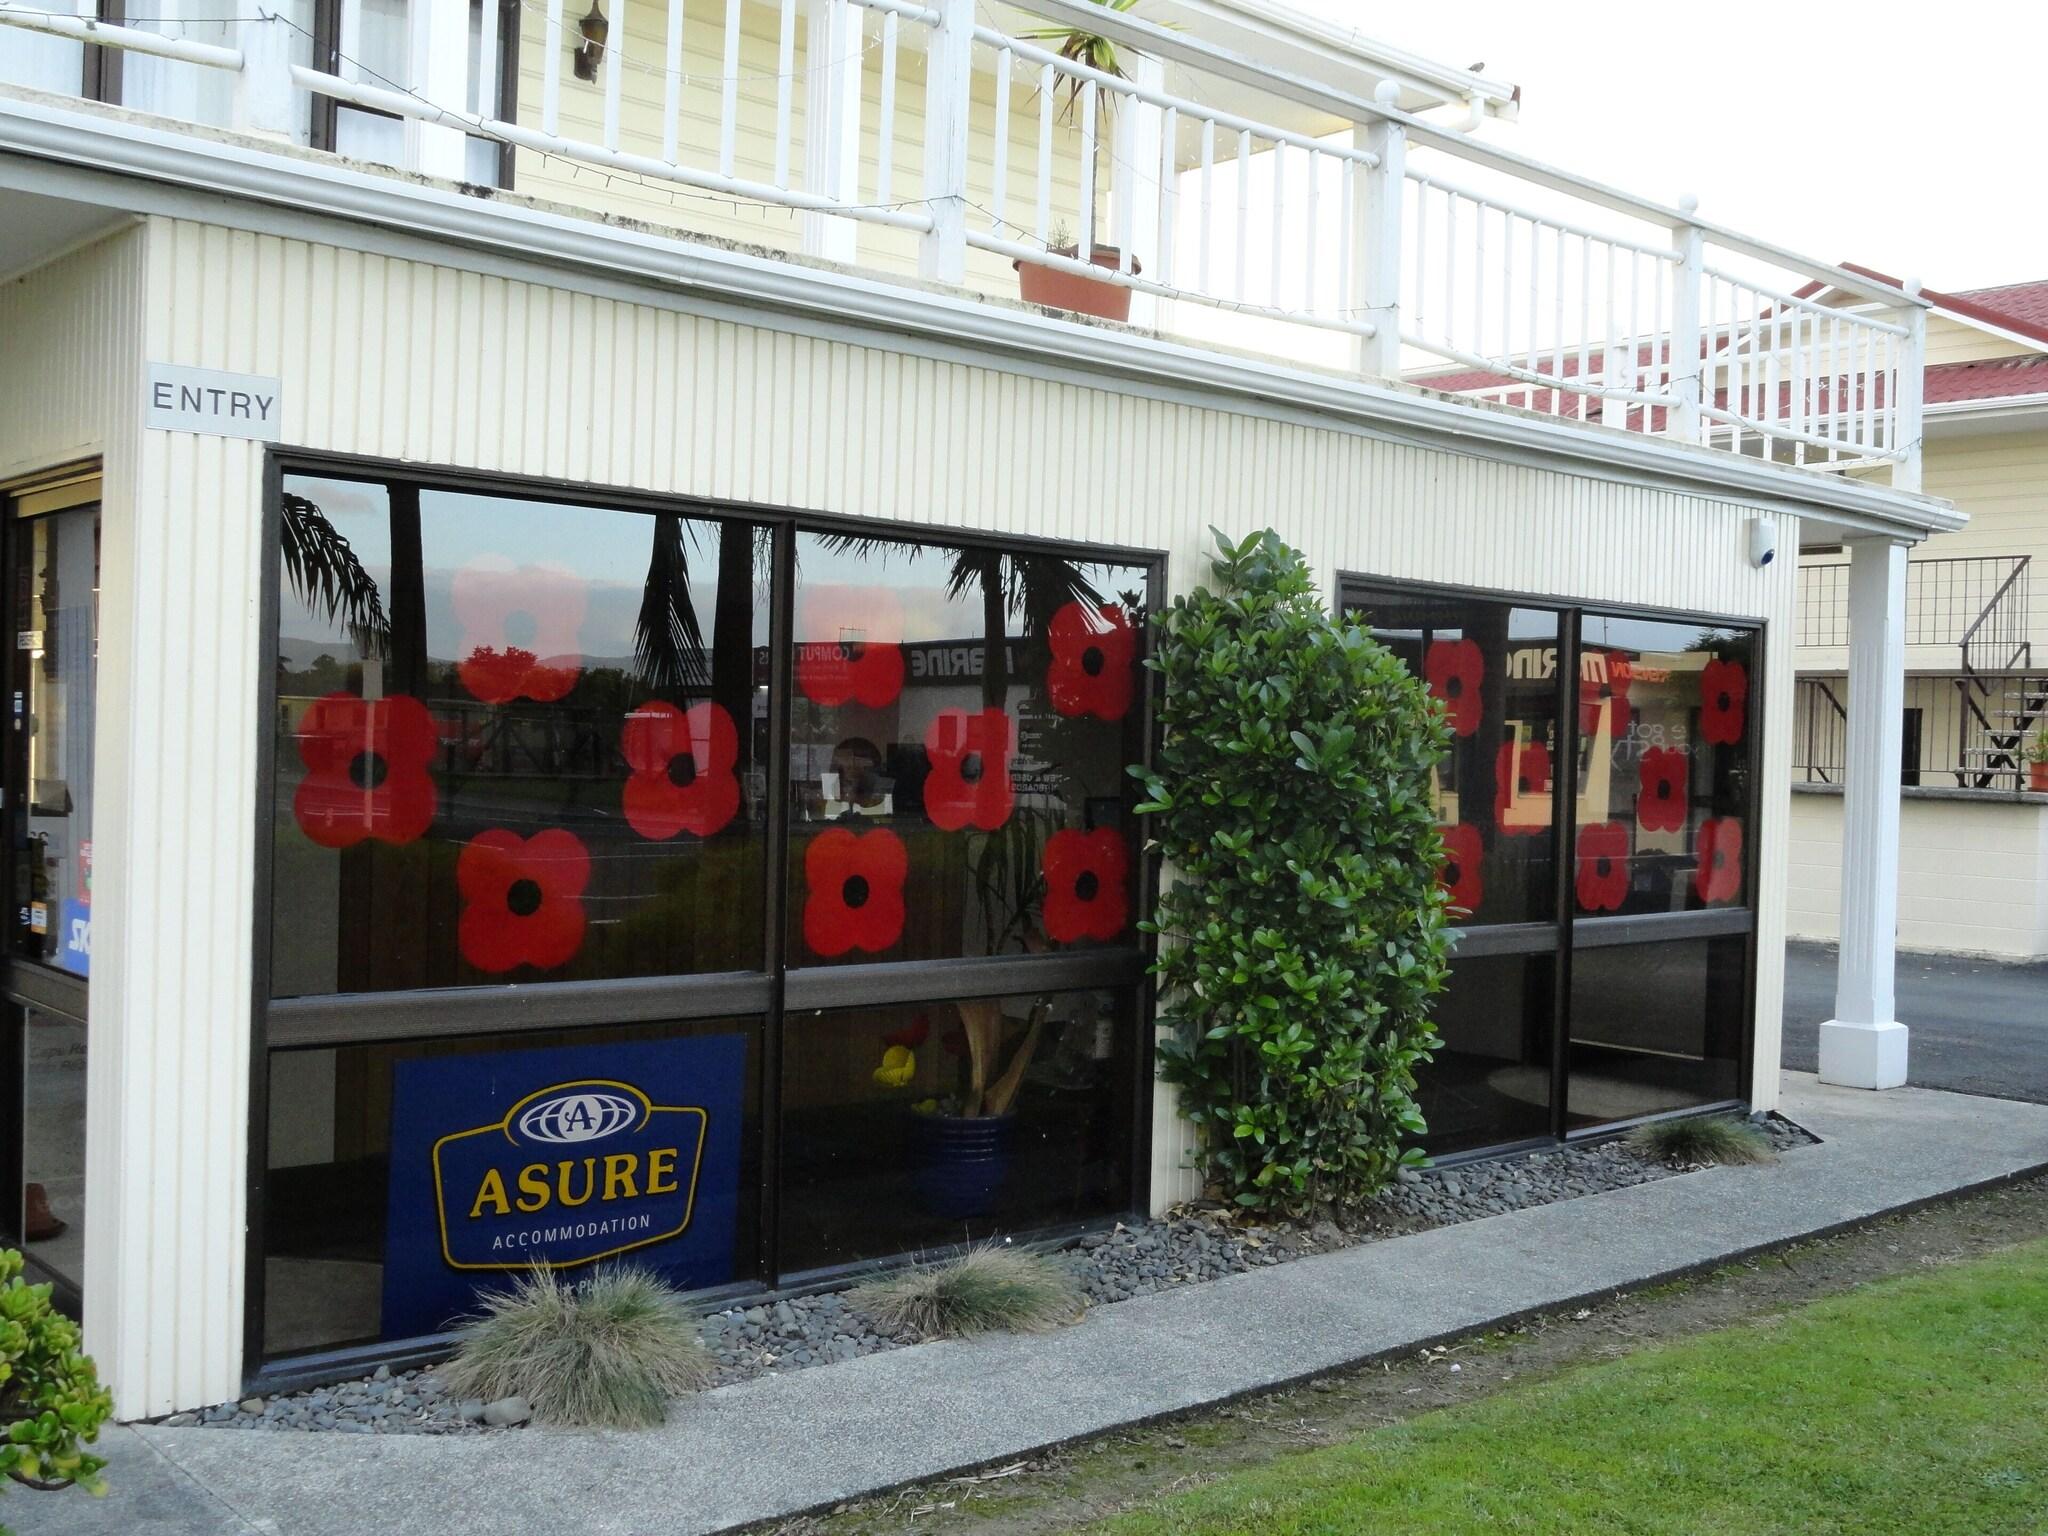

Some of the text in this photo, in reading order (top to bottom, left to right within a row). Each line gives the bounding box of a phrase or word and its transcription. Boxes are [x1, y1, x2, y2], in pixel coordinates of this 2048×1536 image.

[154, 381, 274, 420] ENTRY
[470, 1148, 679, 1217] ASURE
[492, 1214, 651, 1250] ACCOMMODATION
